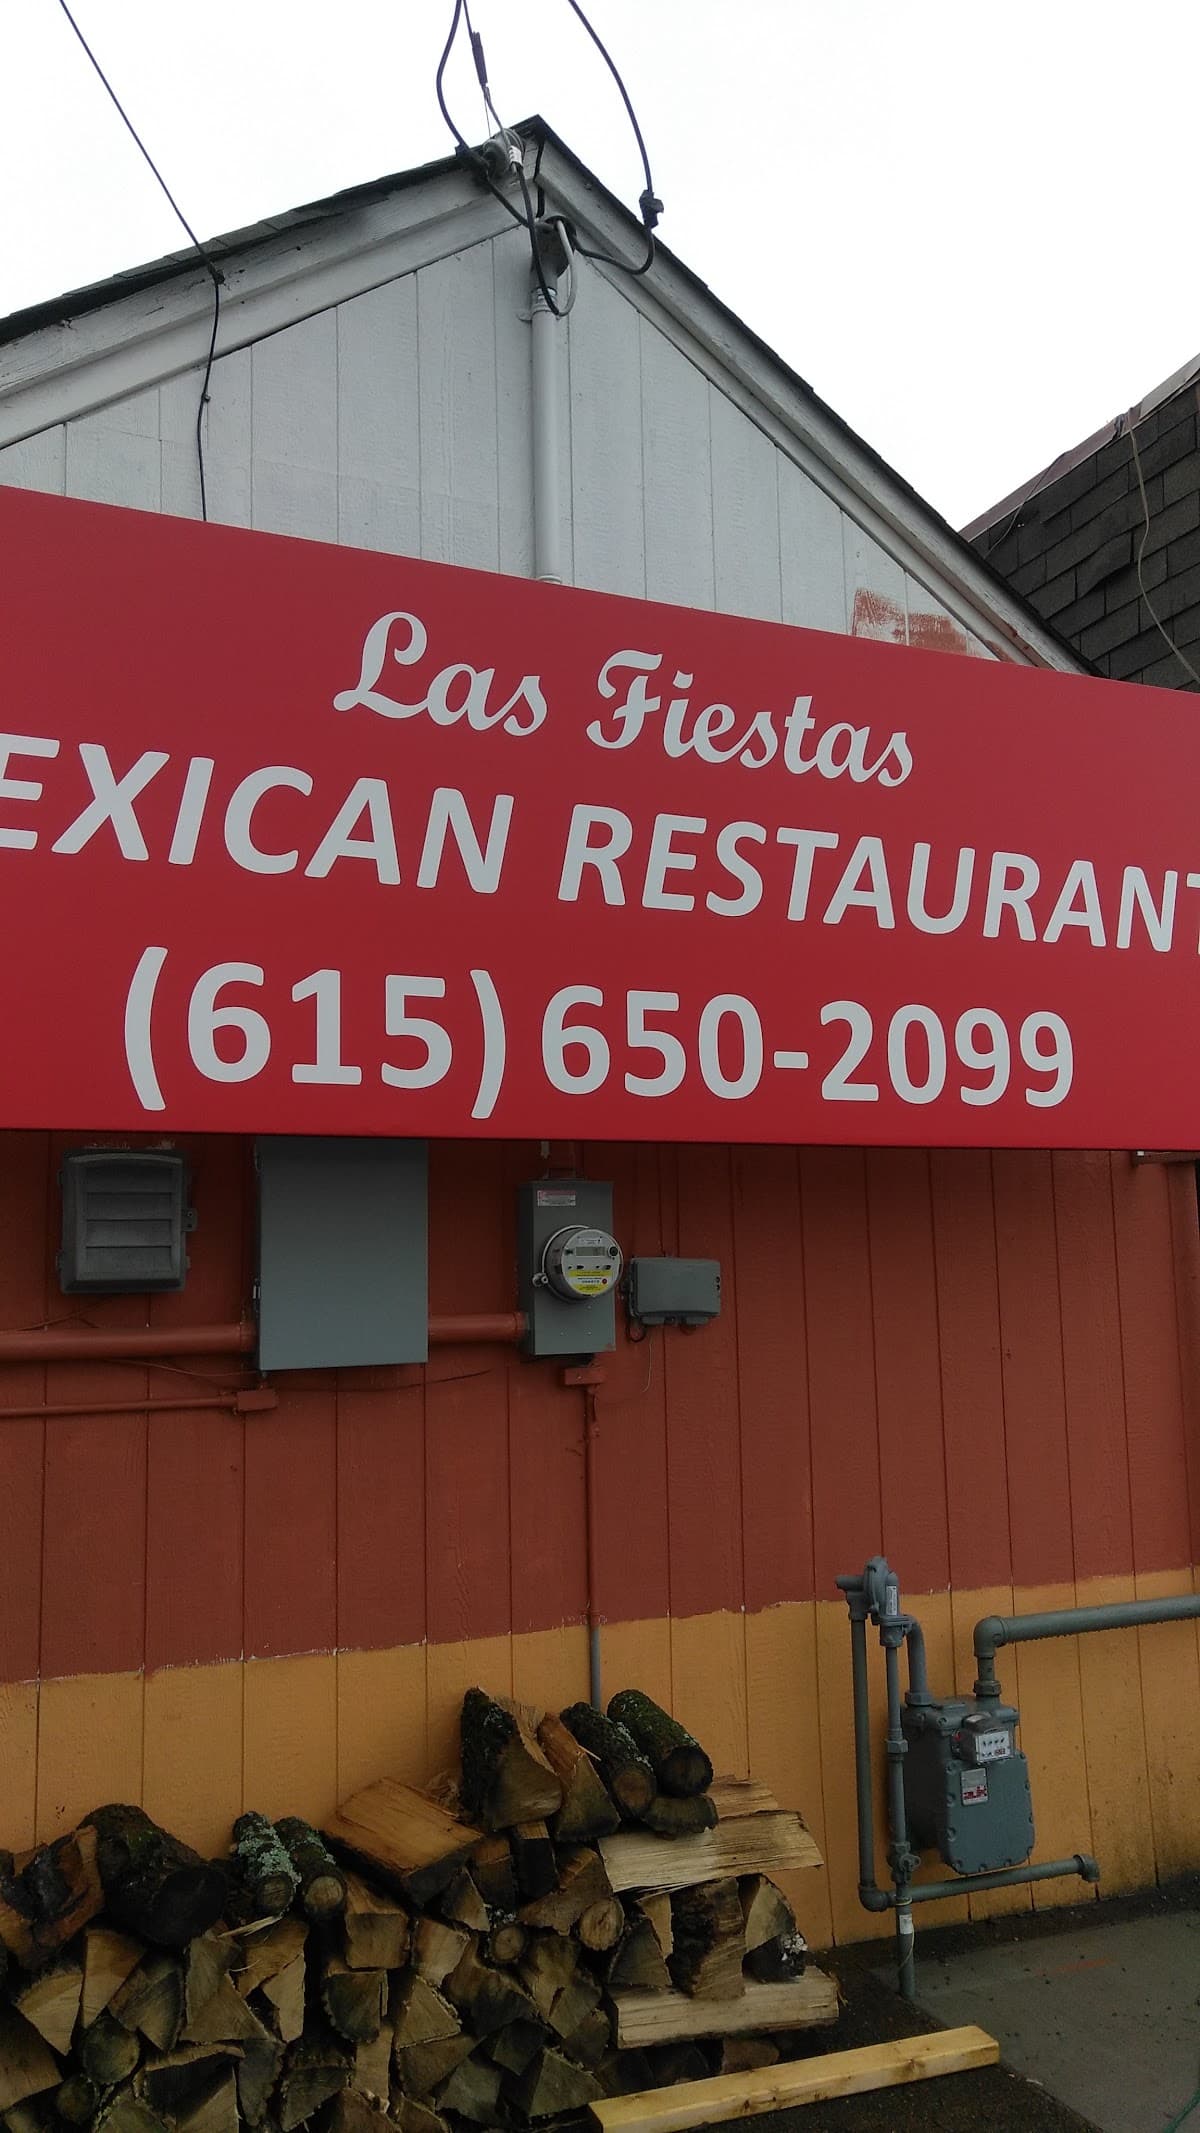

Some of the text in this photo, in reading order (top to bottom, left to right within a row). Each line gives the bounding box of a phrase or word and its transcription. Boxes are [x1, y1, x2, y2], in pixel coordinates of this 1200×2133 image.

[333, 611, 913, 788] Las Fiestas
[124, 946, 1074, 1119] (615) 650-2099
